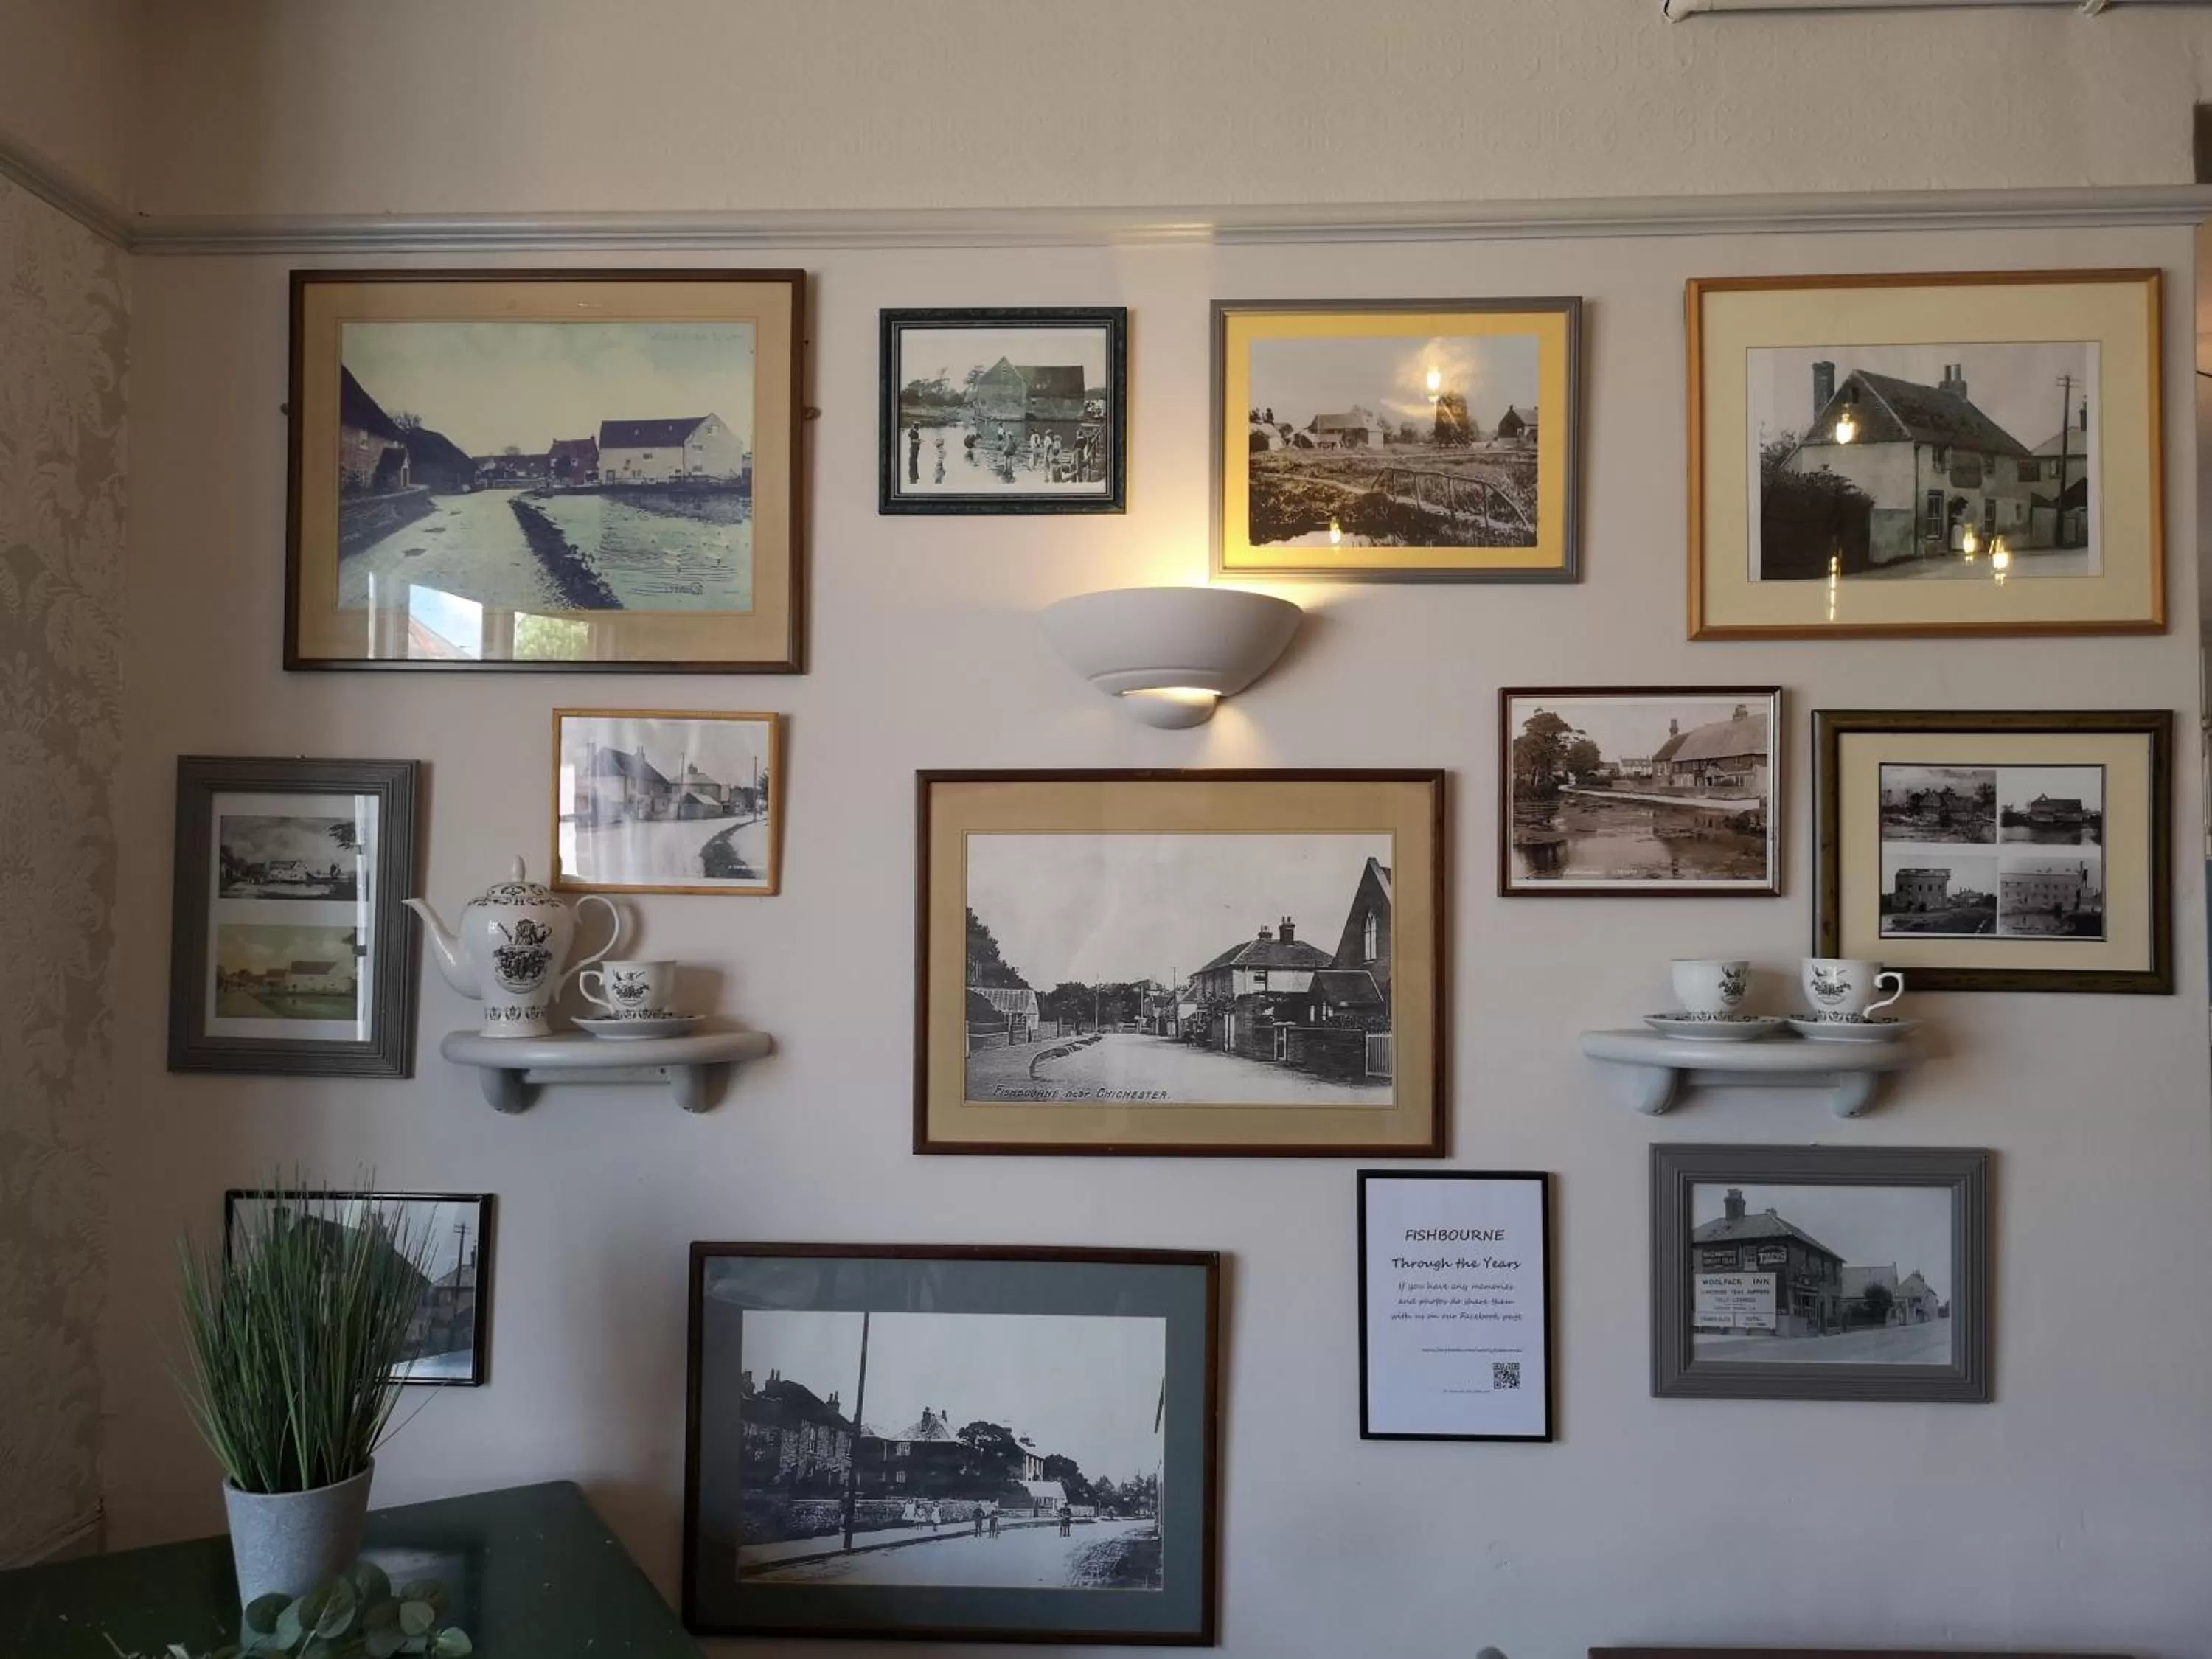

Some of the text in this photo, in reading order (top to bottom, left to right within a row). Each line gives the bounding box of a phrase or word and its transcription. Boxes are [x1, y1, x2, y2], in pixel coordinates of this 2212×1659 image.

[993, 1085, 1060, 1099] FISHBOURNE
[1065, 1089, 1090, 1099] near
[1405, 1228, 1505, 1242] FISHBOURNE
[1392, 1256, 1521, 1271] Through the Years
[1399, 1282, 1405, 1292] If
[1427, 1281, 1447, 1290] have
[1391, 1312, 1413, 1321] with
